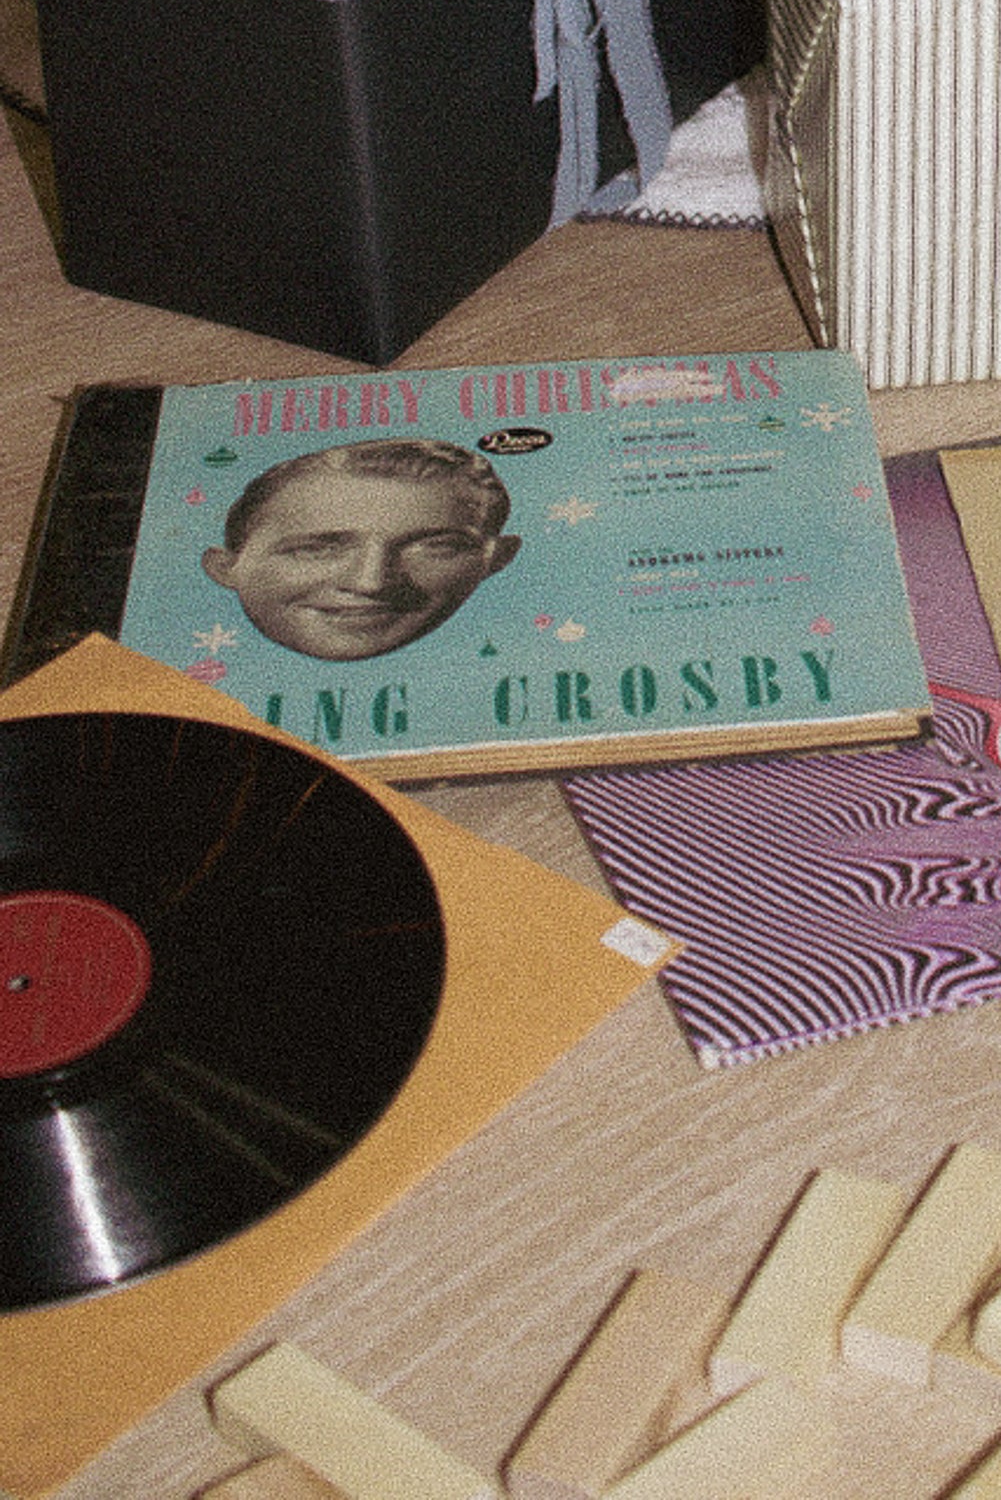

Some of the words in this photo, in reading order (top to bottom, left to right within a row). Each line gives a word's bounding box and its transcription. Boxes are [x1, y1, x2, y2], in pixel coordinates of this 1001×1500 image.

[231, 376, 427, 437] MERRY
[265, 684, 409, 743] ING
[494, 648, 836, 728] CROSBY
